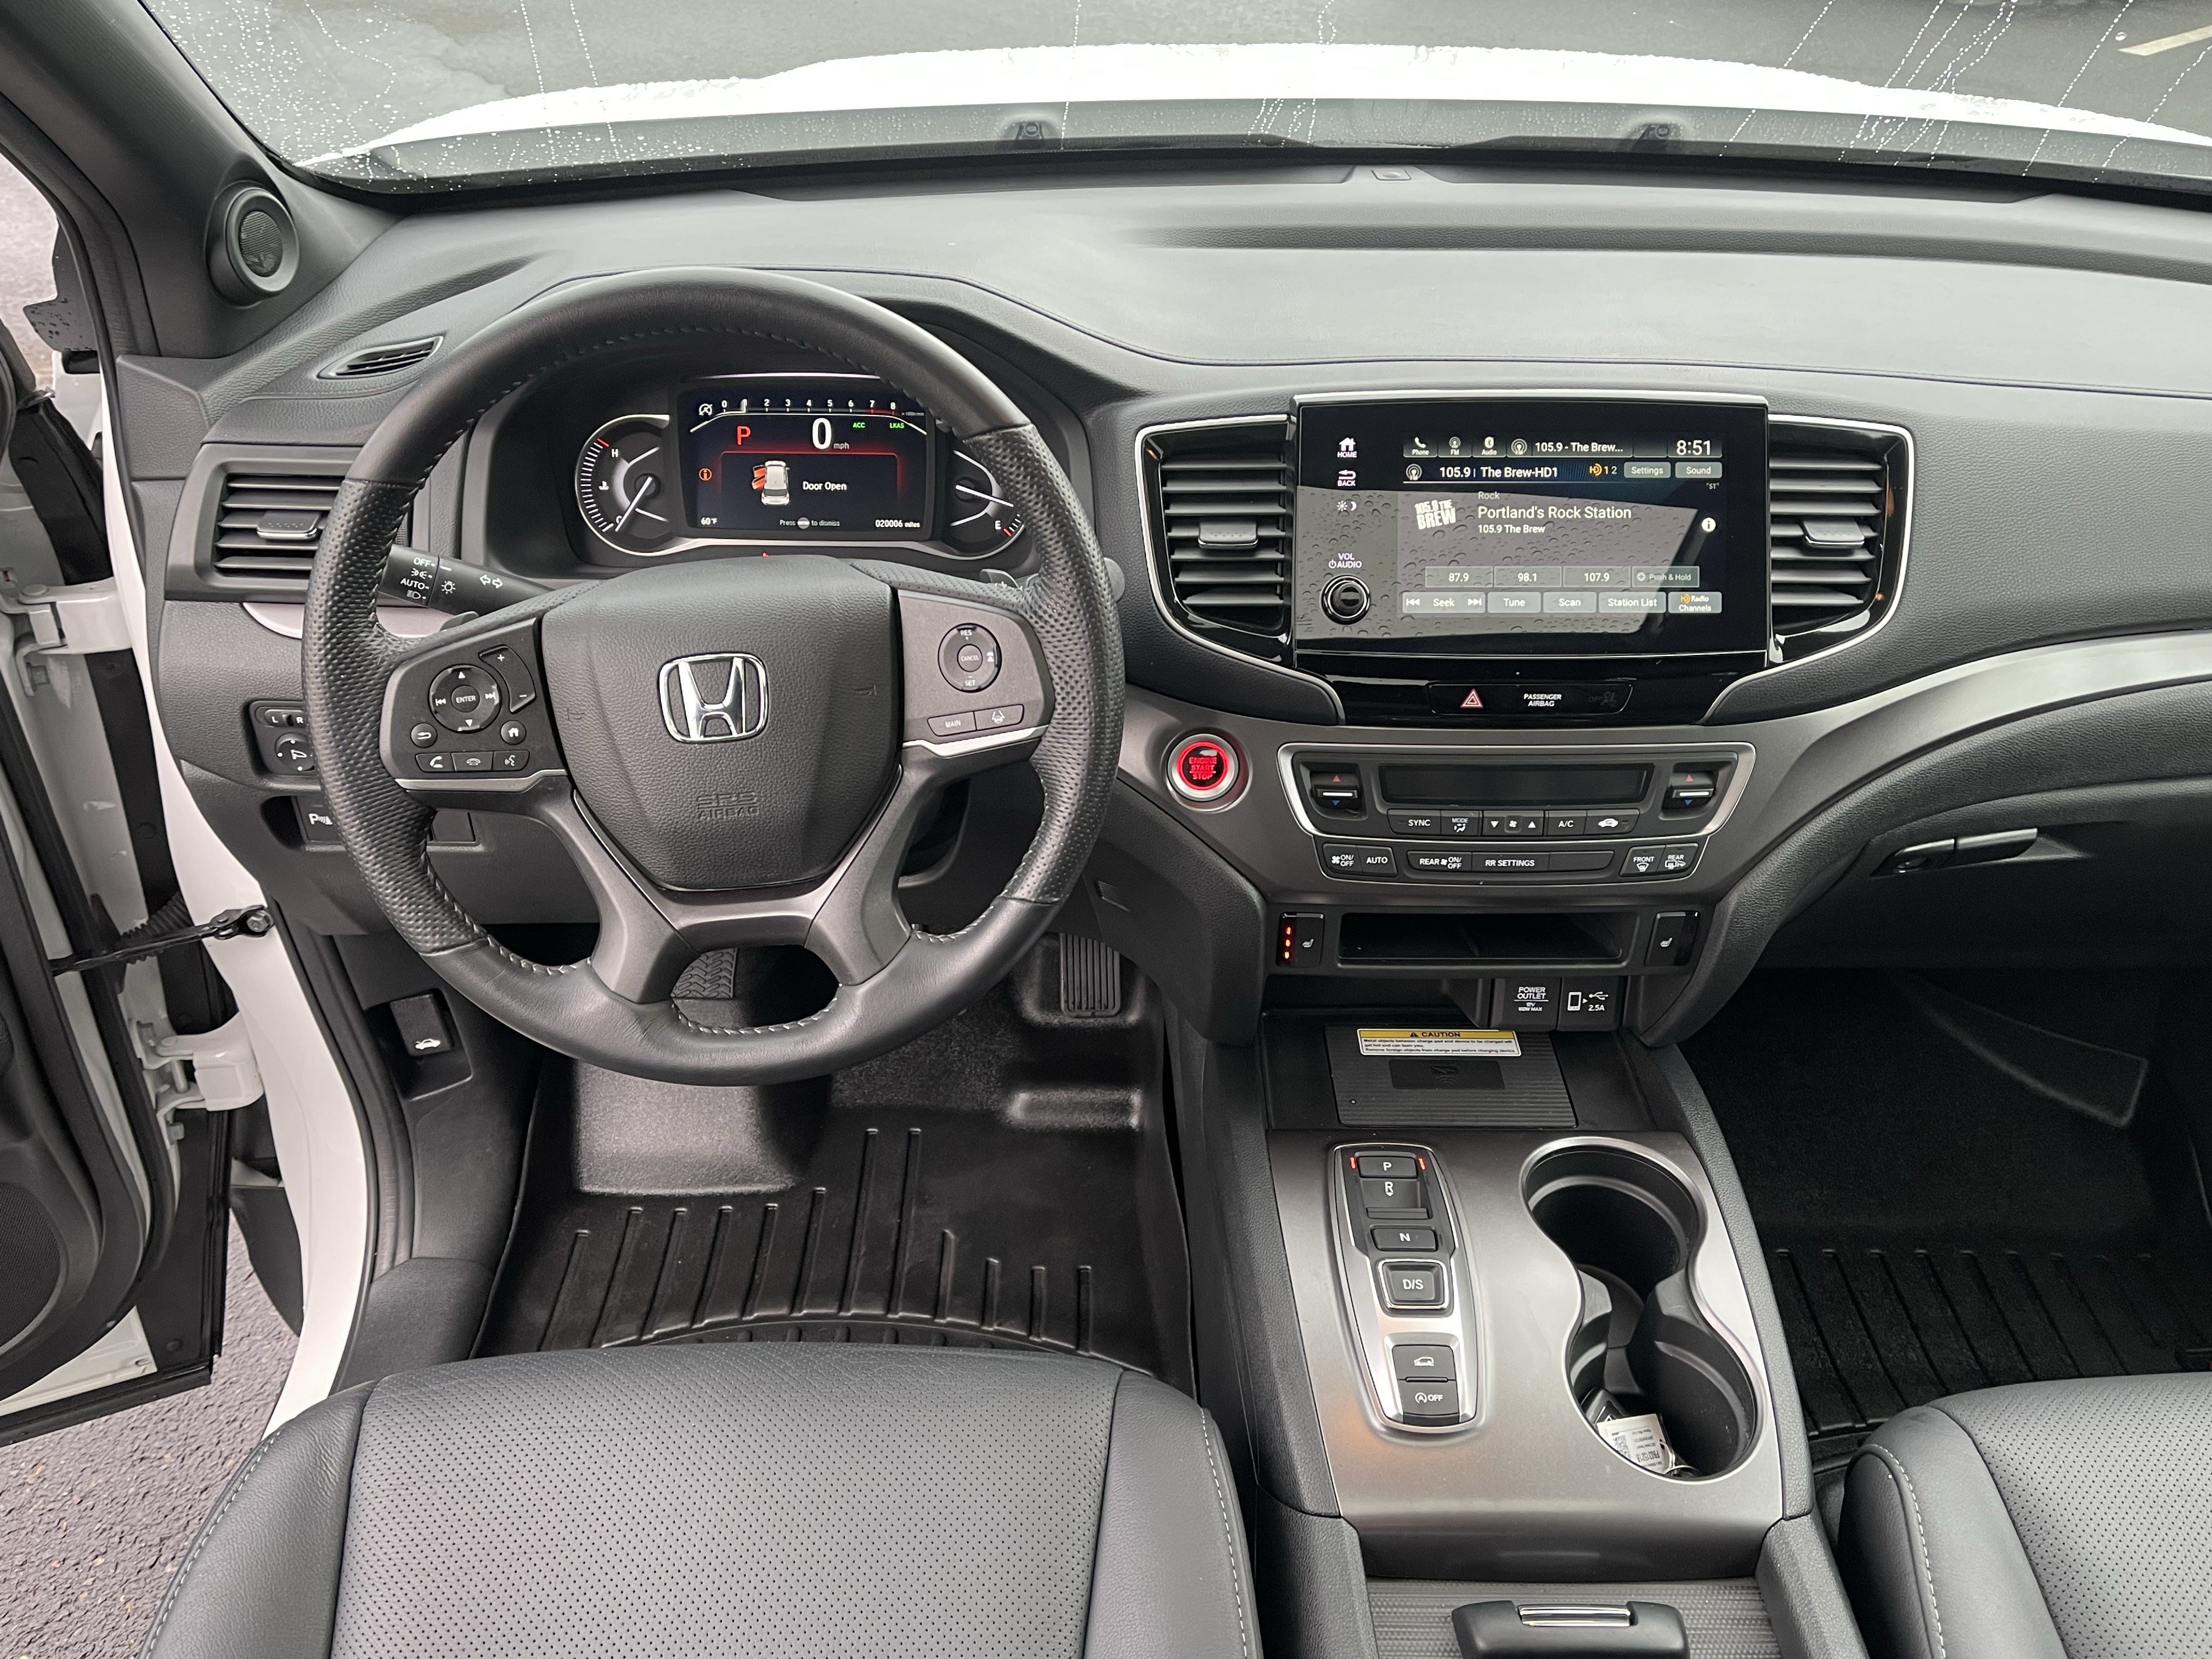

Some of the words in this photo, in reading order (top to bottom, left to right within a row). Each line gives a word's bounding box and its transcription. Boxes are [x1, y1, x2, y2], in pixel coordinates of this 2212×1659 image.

[737, 426, 751, 445] P
[812, 418, 832, 449] 0
[1535, 443, 1563, 452] 105.9
[1571, 443, 1589, 452] The
[1677, 440, 1711, 455] 8:51
[611, 449, 619, 458] H
[1440, 467, 1471, 478] 105.9
[1480, 467, 1502, 478] The
[1504, 467, 1558, 478] Brew-HD1
[1631, 466, 1664, 476] Settings
[1686, 466, 1711, 475] Sound
[803, 482, 823, 491] Door
[825, 482, 847, 493] Open
[1478, 491, 1500, 500] Rock
[1477, 505, 1545, 519] Portland's
[1548, 506, 1581, 519] Rock
[1584, 506, 1632, 519] Station
[1416, 507, 1456, 530] BREW
[875, 519, 903, 528] 020006
[995, 521, 1002, 530] E
[1478, 524, 1503, 533] 105.9
[1504, 524, 1521, 533] The
[1523, 524, 1546, 533] Brew
[414, 557, 431, 567] OFF
[1448, 573, 1470, 582] 87.9
[1517, 573, 1537, 582] 98.1
[1584, 573, 1610, 582] 107.9
[400, 578, 425, 590] AUTO
[1433, 598, 1455, 607] Seek
[1503, 598, 1526, 607] Tune
[1559, 598, 1581, 607] Scan
[1607, 597, 1639, 607] Station
[1641, 598, 1657, 607] List
[1679, 604, 1712, 612] Channels
[455, 695, 476, 704] ENTER
[271, 716, 279, 724] L
[296, 716, 304, 724] R
[945, 720, 961, 728] MAIN
[1408, 819, 1431, 827] SYNC
[1497, 859, 1535, 867] SETTINGS
[1383, 1162, 1392, 1171] P
[1384, 1181, 1394, 1193] R
[1400, 1233, 1410, 1242] N
[1403, 1279, 1424, 1290] D/S
[1427, 1394, 1443, 1402] OFF
